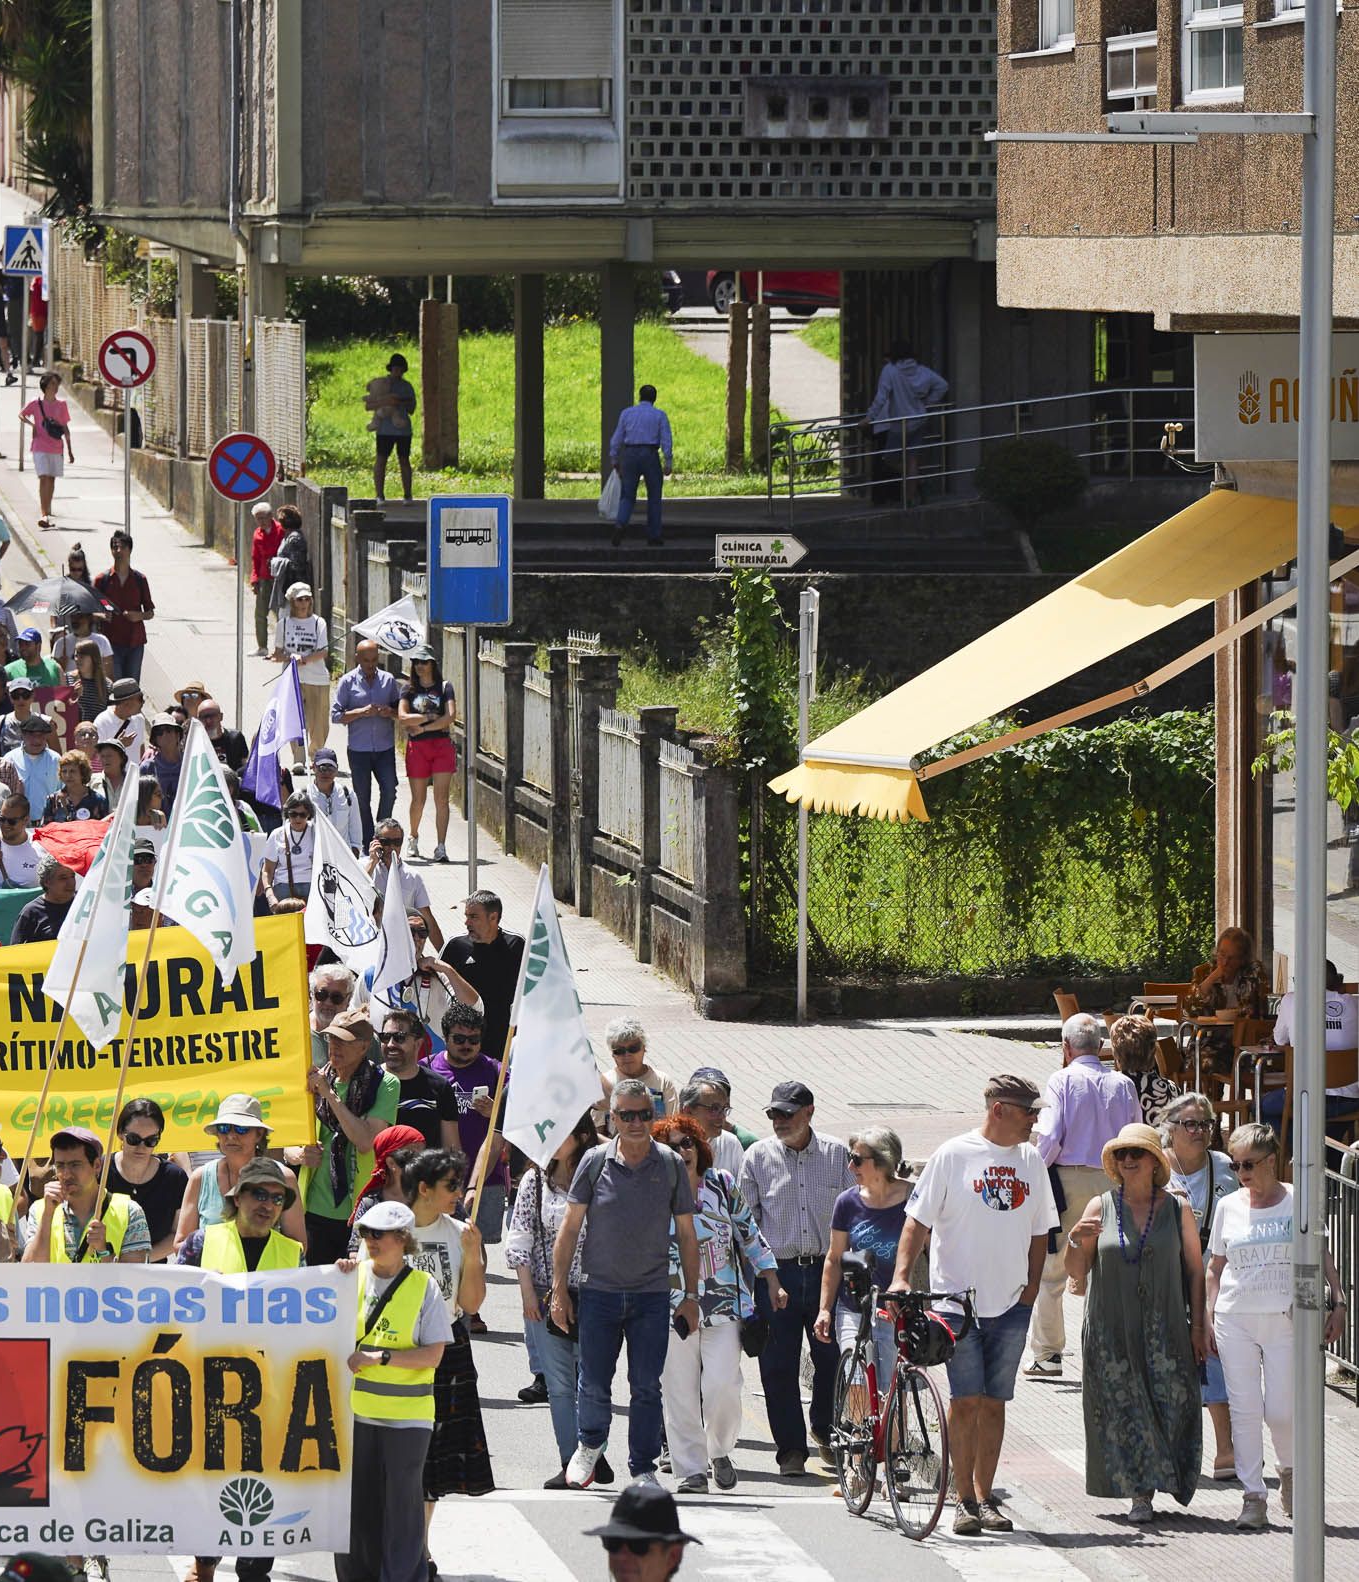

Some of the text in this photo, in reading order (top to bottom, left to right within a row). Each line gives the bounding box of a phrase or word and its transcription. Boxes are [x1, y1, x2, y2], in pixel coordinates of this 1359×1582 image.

[721, 555, 788, 564] VETERINARIA
[722, 541, 762, 551] CLÍNICA
[8, 951, 279, 1023] NURAL
[25, 1284, 206, 1325] nosas
[63, 1332, 341, 1473] FÓRA
[40, 1518, 74, 1543] de
[84, 1517, 174, 1544] Galiza
[219, 1527, 312, 1547] ADEGA
